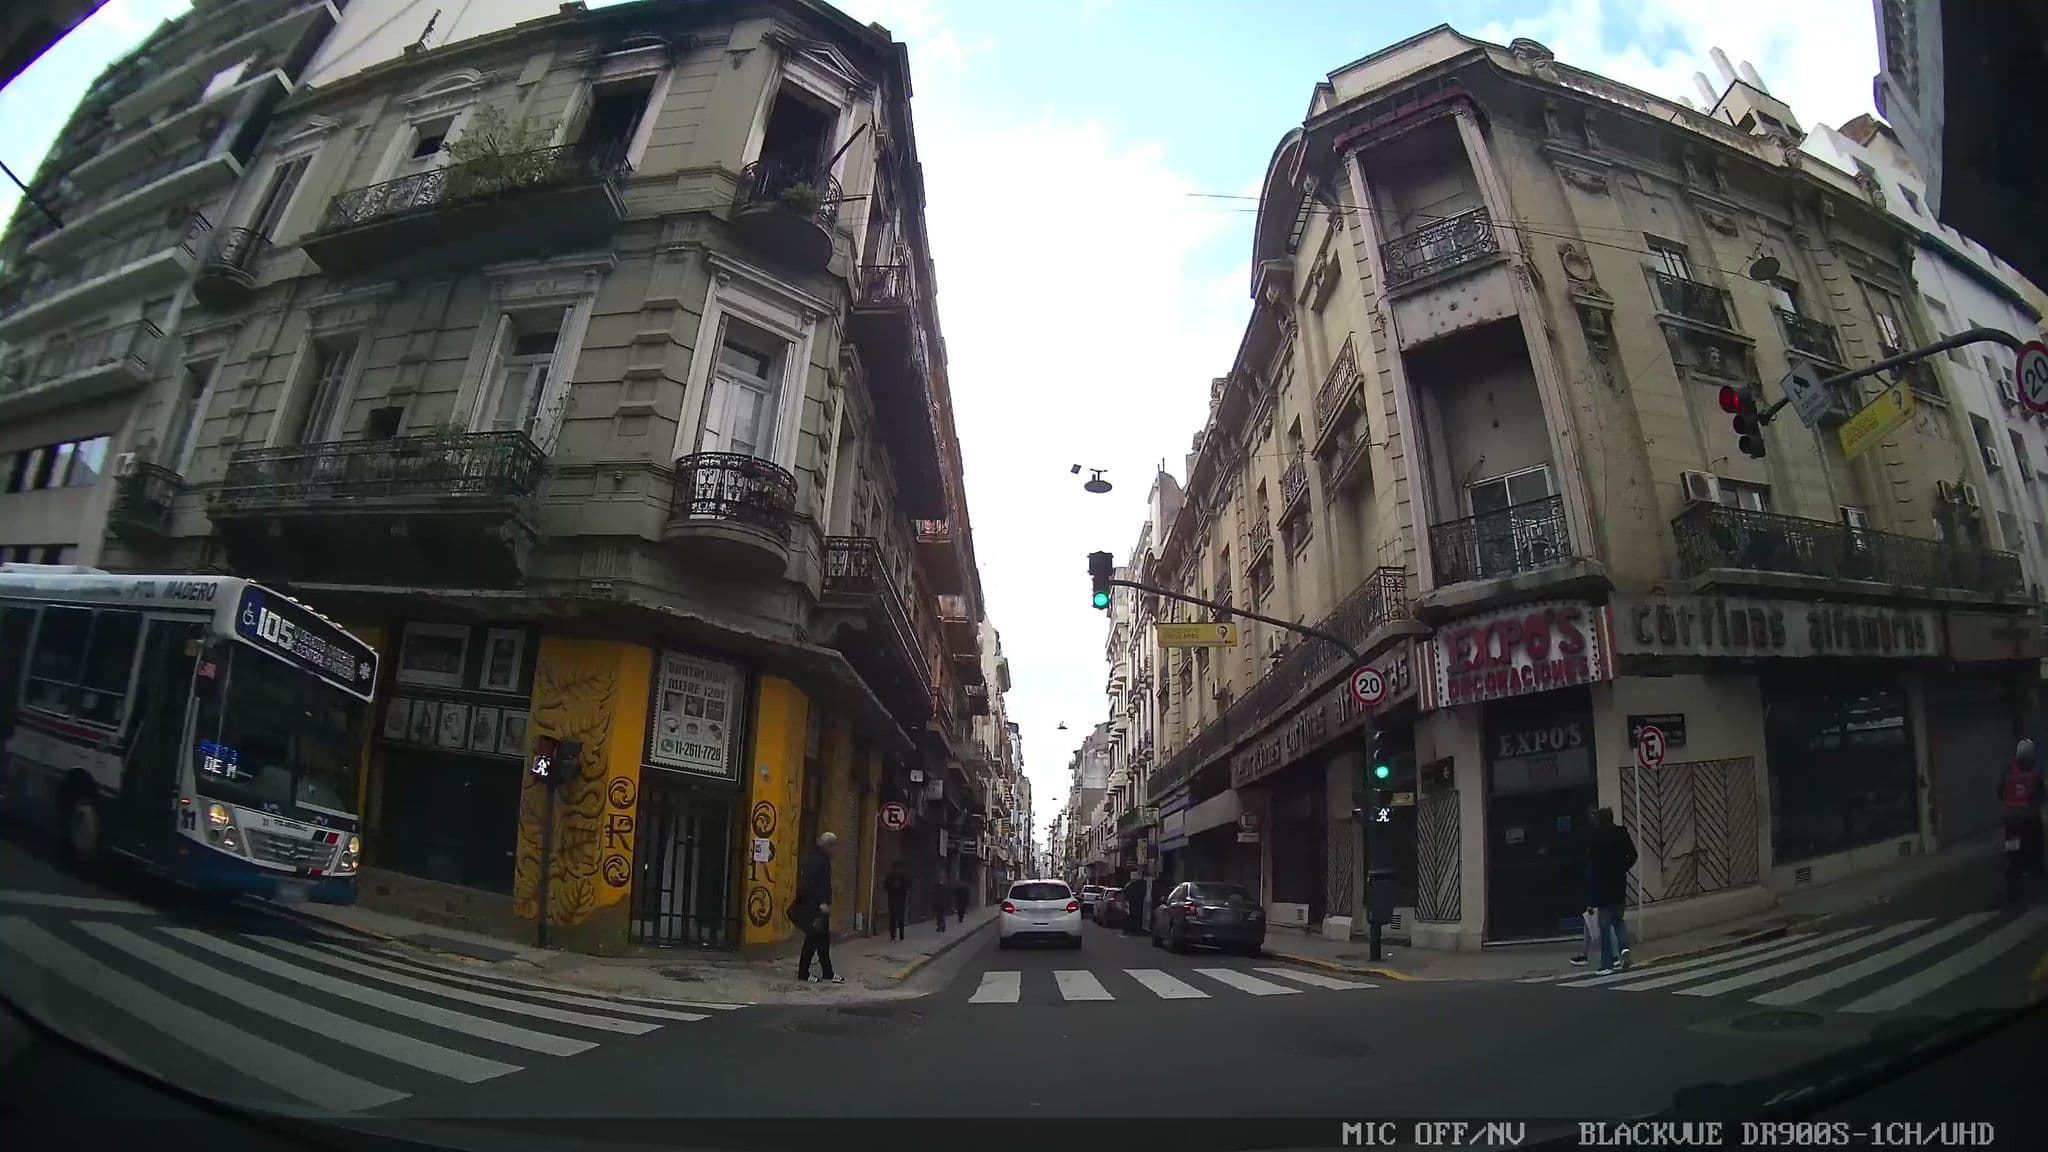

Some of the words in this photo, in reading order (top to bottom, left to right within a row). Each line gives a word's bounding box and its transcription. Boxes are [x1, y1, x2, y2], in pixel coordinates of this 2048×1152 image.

[2025, 356, 2048, 398] 20
[164, 581, 218, 601] MADERO
[256, 607, 296, 650] 105
[1358, 678, 1380, 694] 20
